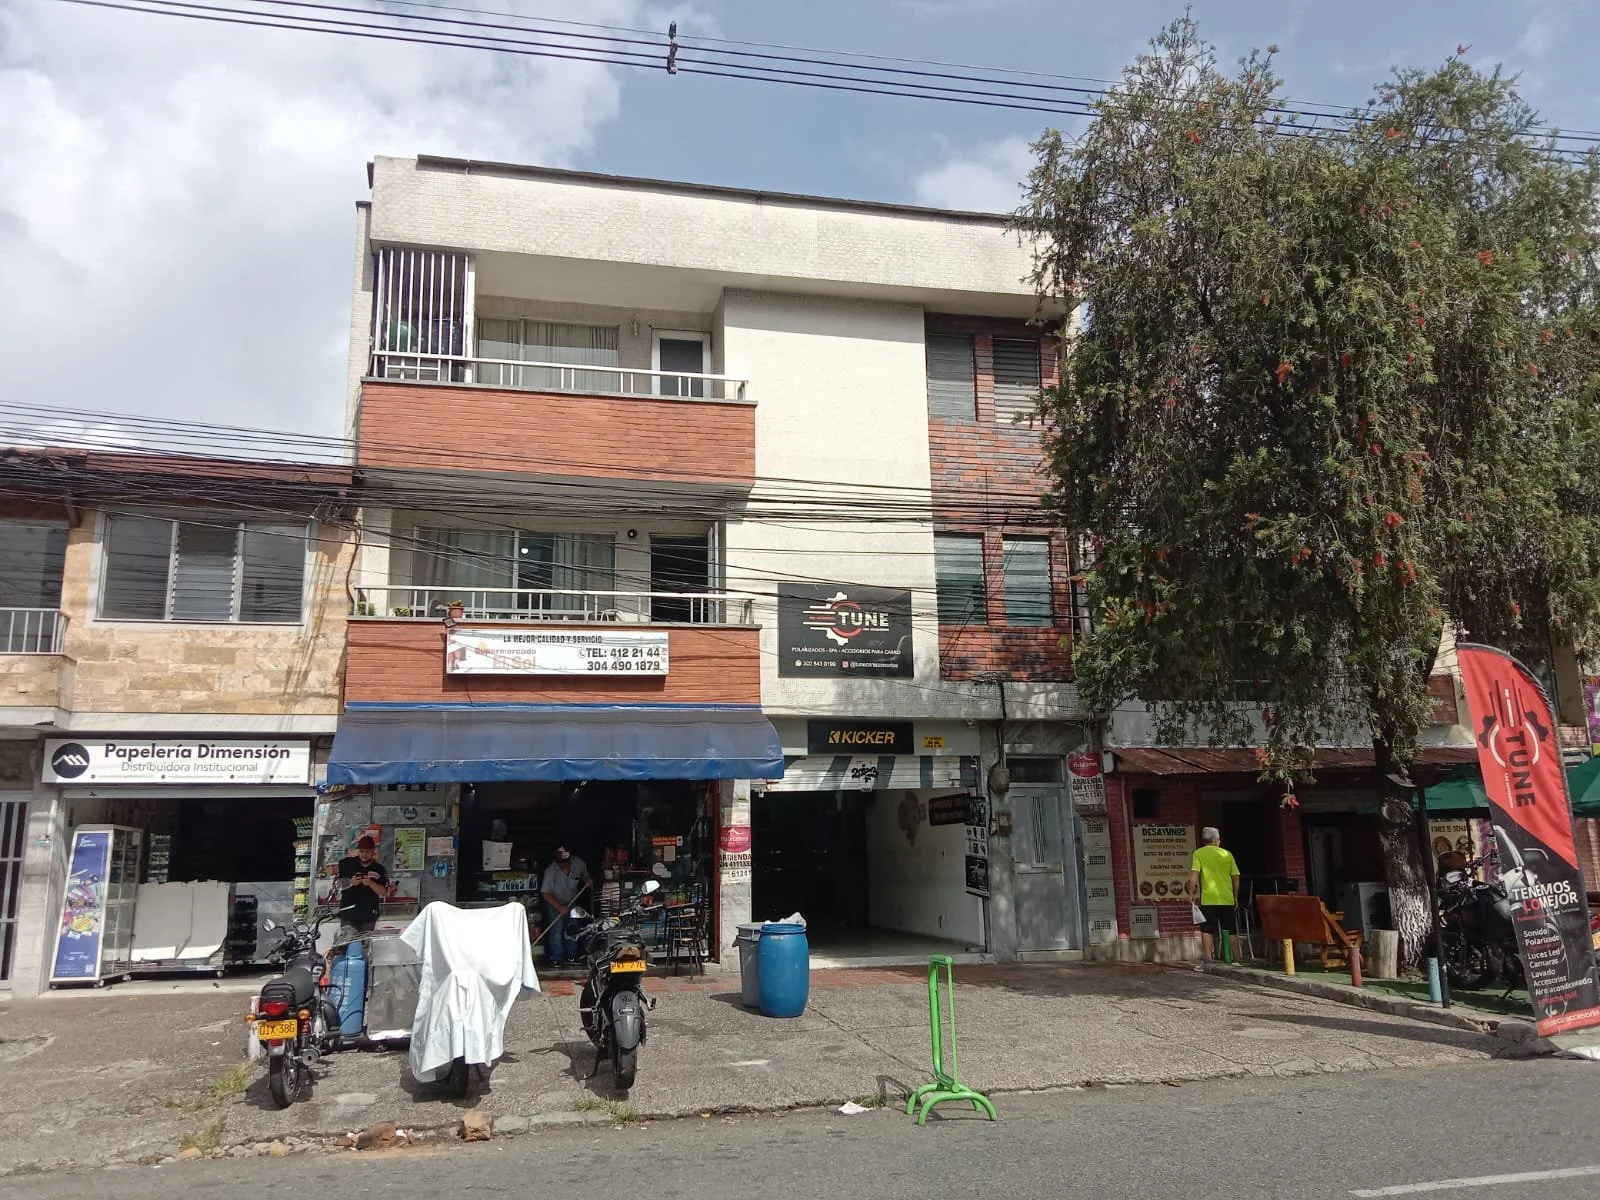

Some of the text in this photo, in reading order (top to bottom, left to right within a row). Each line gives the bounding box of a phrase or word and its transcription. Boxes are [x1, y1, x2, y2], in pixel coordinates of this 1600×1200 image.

[838, 611, 889, 627] TUNE
[513, 635, 535, 644] MEJOR
[538, 635, 566, 644] CALIDAD
[572, 635, 603, 644] SERVICIO
[586, 648, 661, 659] TEL: 412 21 44
[587, 661, 661, 671] 304 490 1879
[841, 731, 895, 745] KICKER
[105, 743, 290, 761] Papelería Dimensión
[121, 761, 258, 772] Distribuidora Institucional
[1505, 731, 1536, 807] TUNE
[1142, 827, 1186, 837] DESAYUNOS
[1512, 880, 1571, 900] TENEMOS
[1523, 892, 1579, 913] LO MEJOR
[1523, 928, 1548, 938] Sonido
[1525, 934, 1560, 947] Polarizado
[1527, 948, 1561, 960] Luces Led
[1531, 969, 1556, 979] Lavado
[1533, 975, 1567, 987] Accesorios
[1535, 986, 1549, 997] Aire
